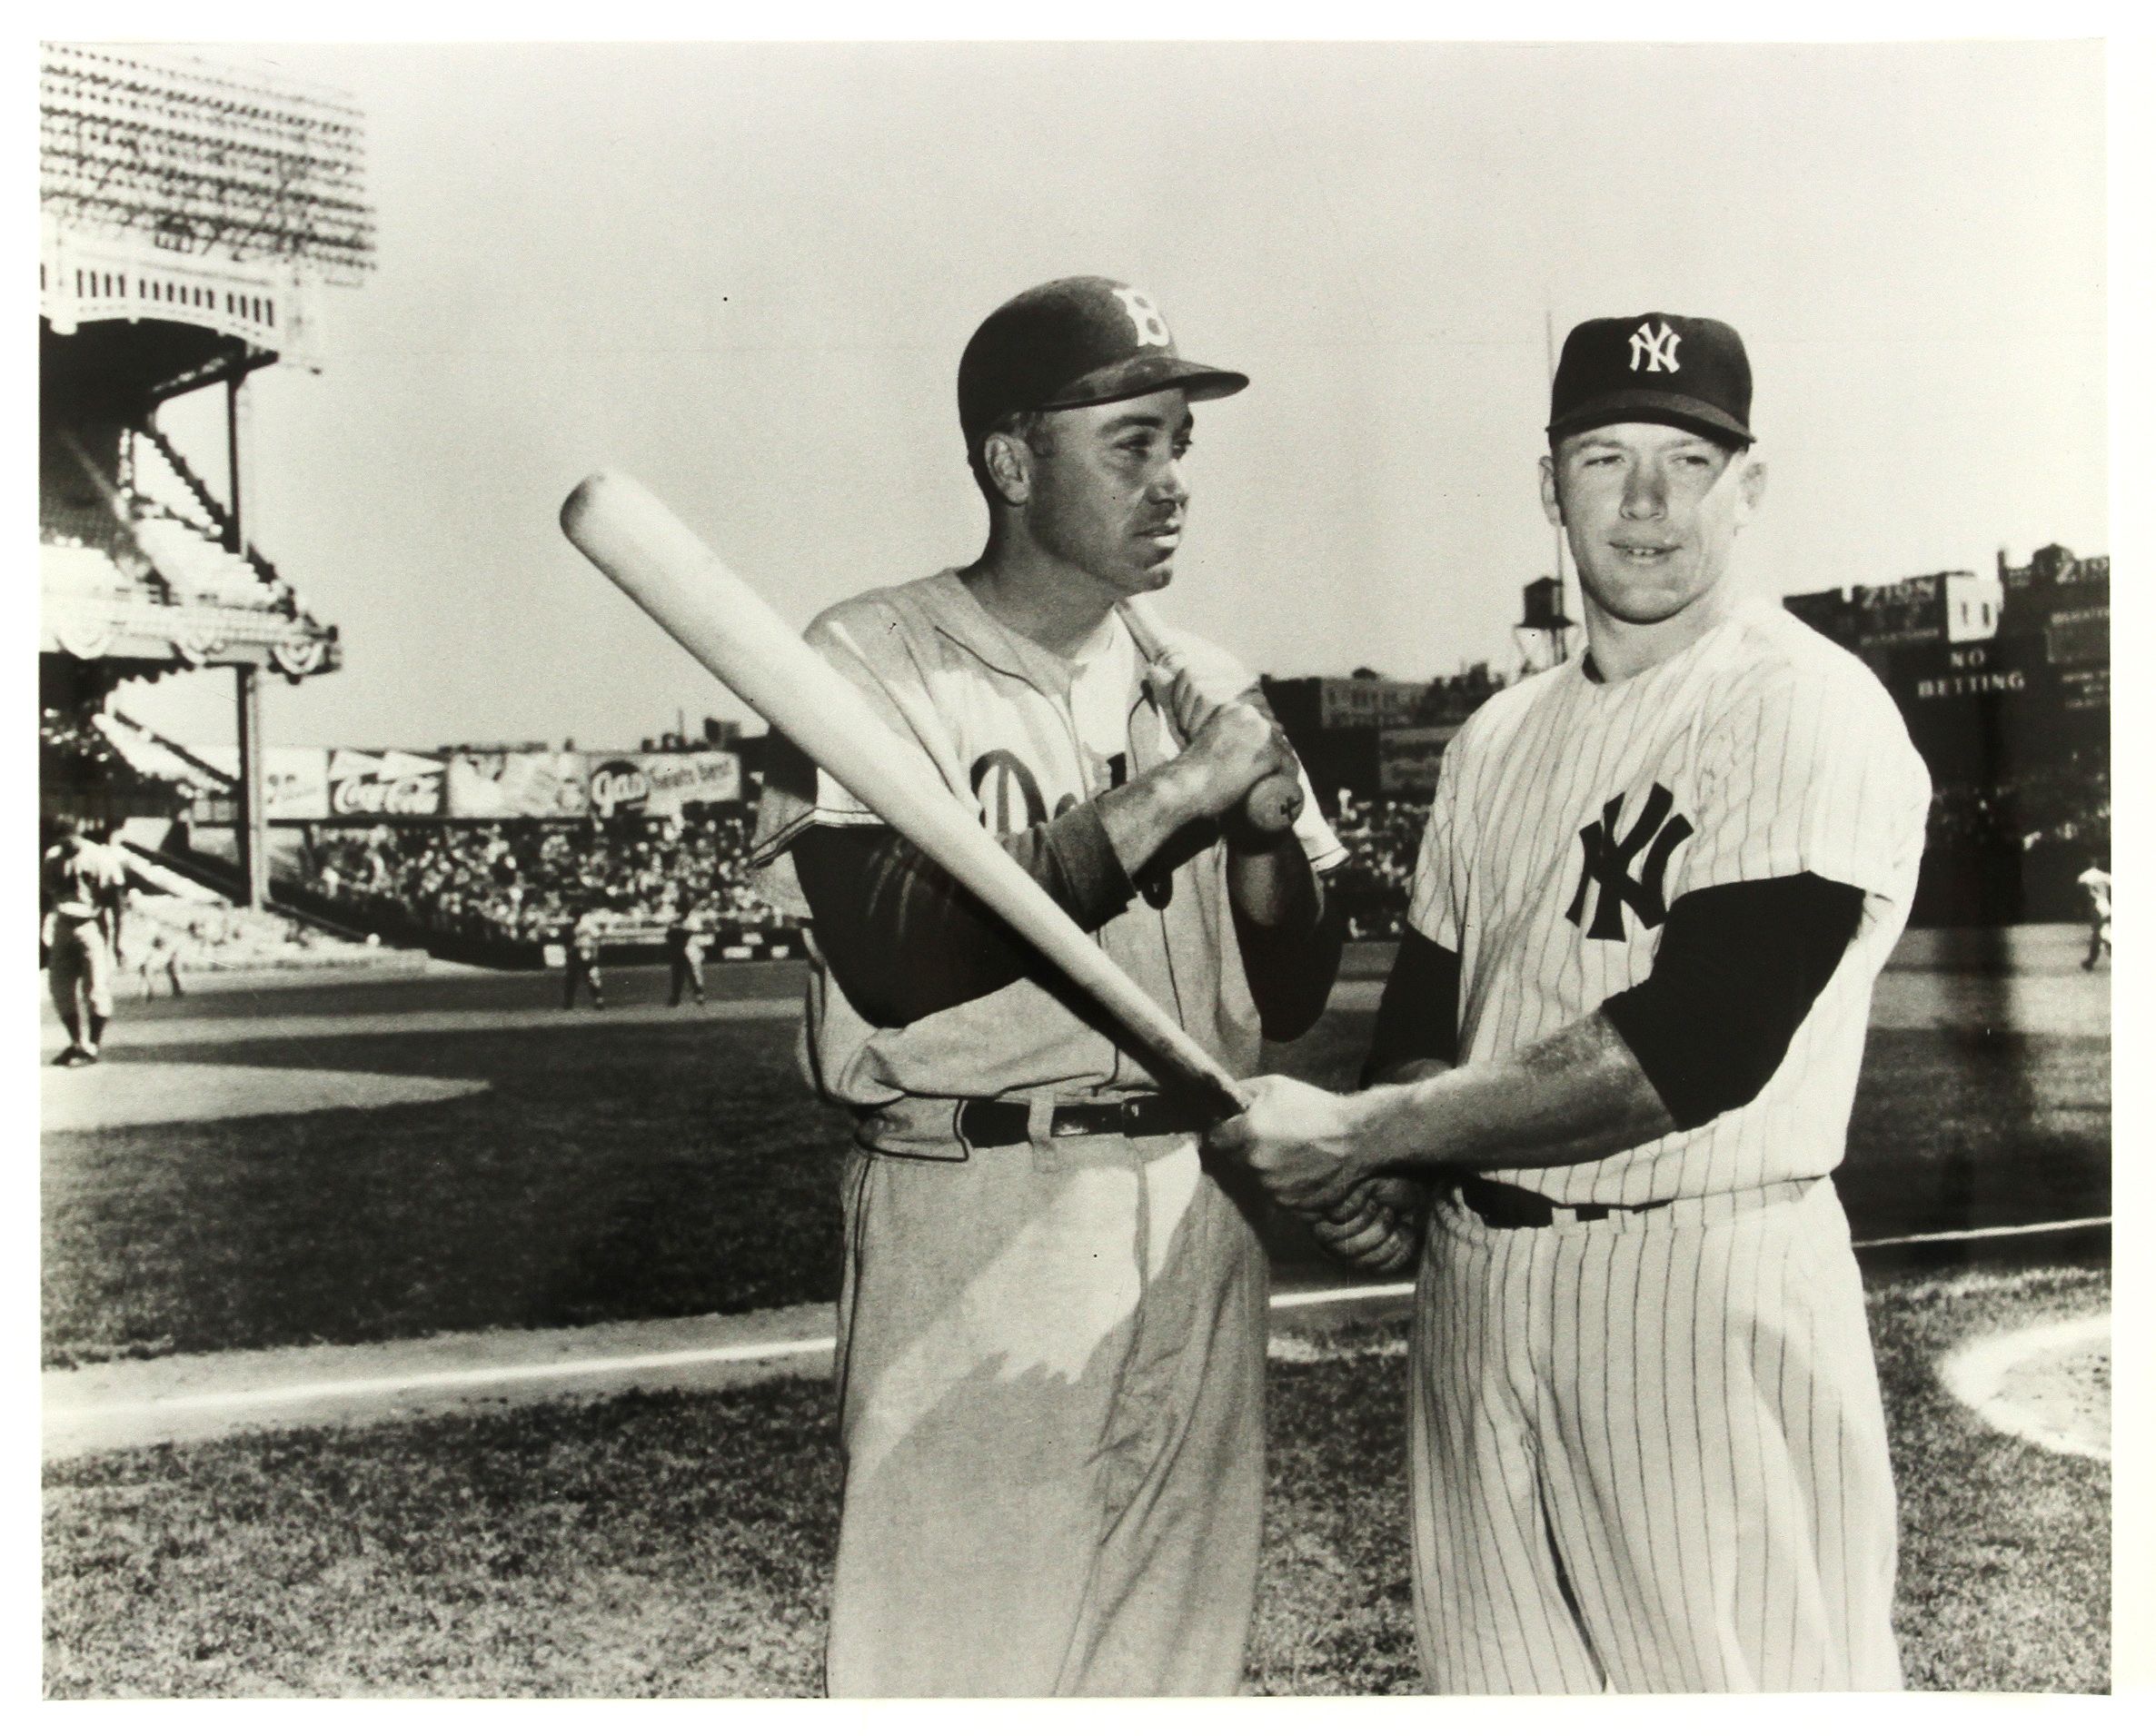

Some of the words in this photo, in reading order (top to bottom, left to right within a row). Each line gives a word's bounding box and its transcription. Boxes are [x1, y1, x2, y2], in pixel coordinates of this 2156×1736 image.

[1111, 289, 1169, 346] B
[1628, 322, 1682, 373] NY
[1950, 647, 1987, 669] NO
[1917, 670, 2026, 699] BETTING
[1565, 781, 1694, 942] NY
